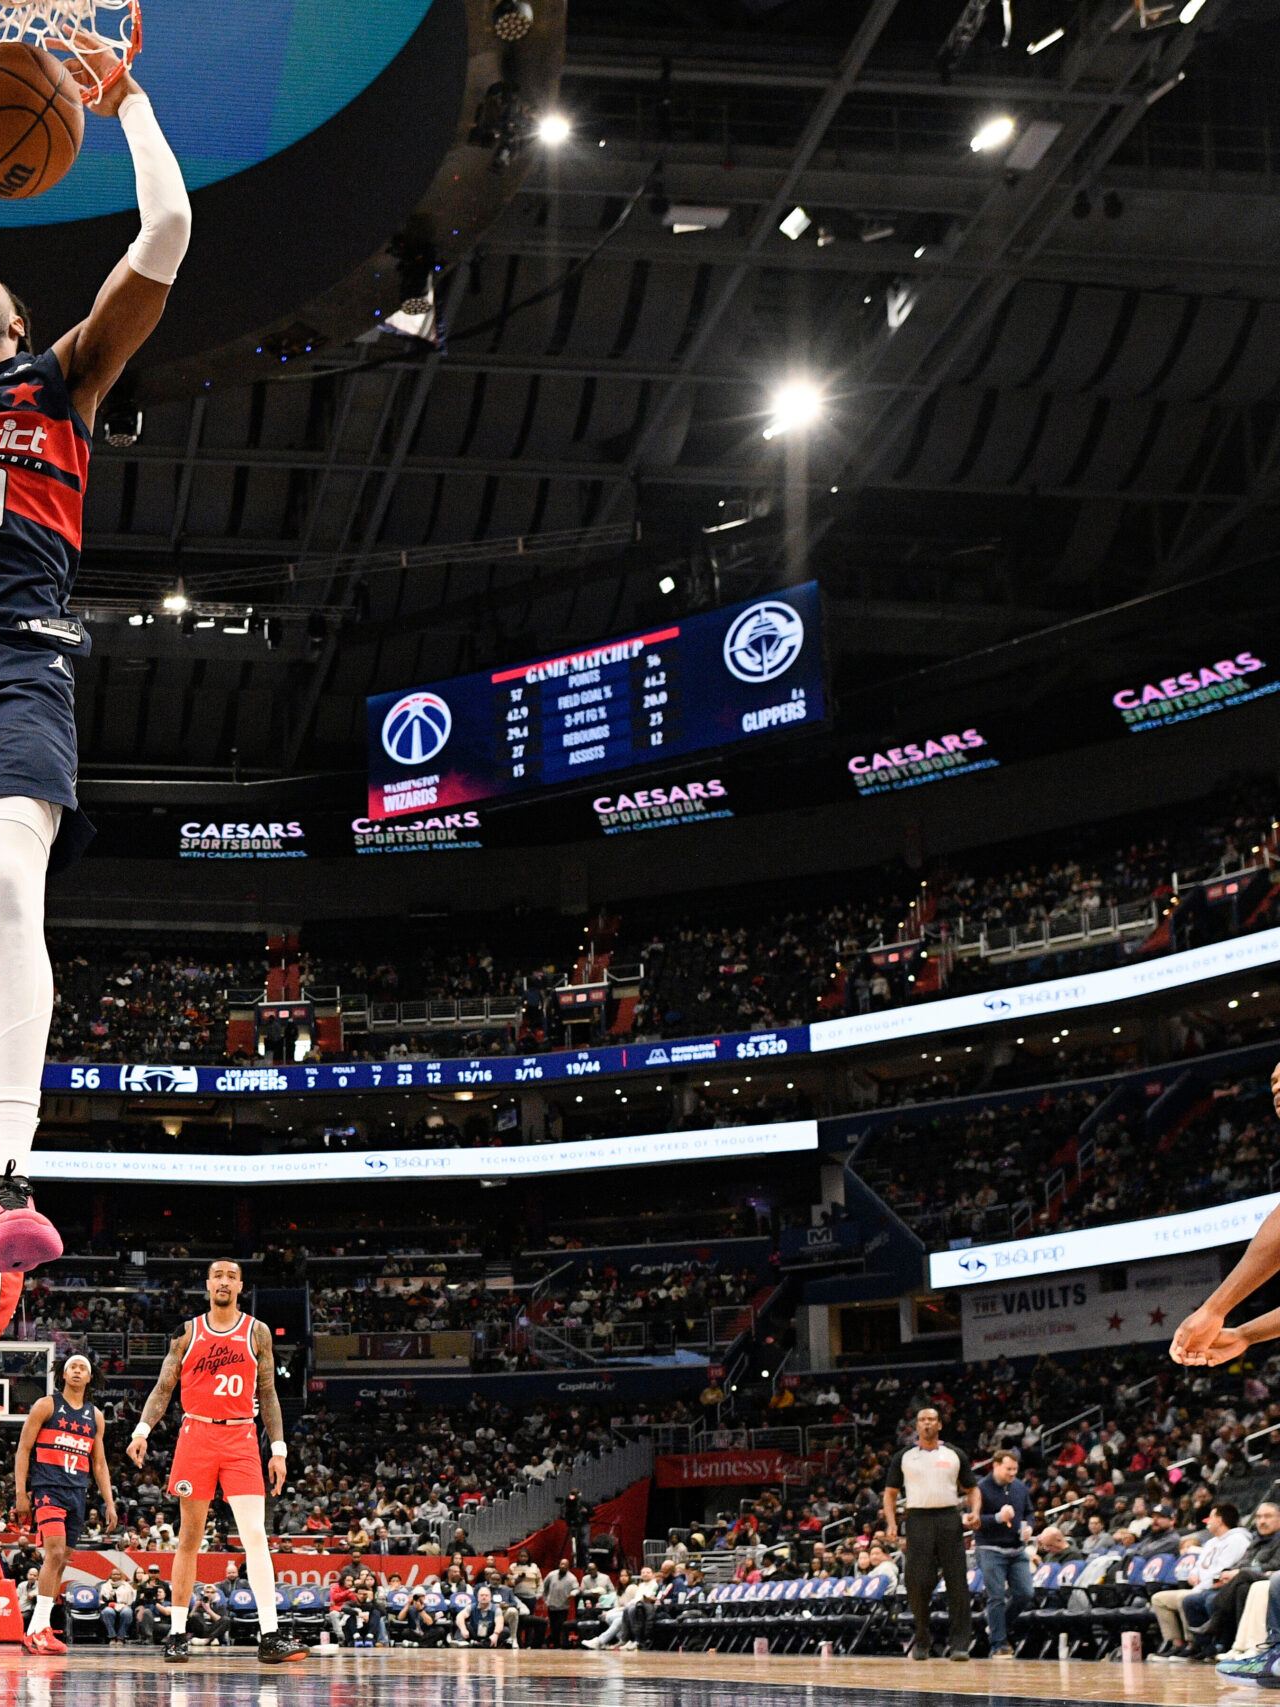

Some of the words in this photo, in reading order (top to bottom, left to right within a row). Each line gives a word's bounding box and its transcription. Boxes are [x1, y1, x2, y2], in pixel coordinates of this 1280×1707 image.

[525, 659, 569, 685] GAME
[569, 639, 644, 671] MATCHUP
[568, 669, 601, 688] POINTS
[1112, 651, 1264, 710] CAESARS
[557, 693, 580, 711] FIELD
[581, 690, 602, 707] GOAL
[1121, 678, 1250, 724] SPORTSBOOK
[564, 712, 585, 728] 3-PT
[742, 700, 806, 734] CLIPPERS
[563, 724, 610, 748] REBOUNDS
[568, 745, 606, 766] ASSISTS
[650, 731, 663, 746] 12
[848, 728, 985, 776] CAESARS
[853, 751, 968, 788] SPORTSBOOK
[383, 774, 440, 793] WASHINGTON
[383, 787, 438, 813] WIZARDS
[592, 779, 725, 815] CAESARS
[598, 799, 707, 827] SPORTSBOOK
[180, 821, 304, 839] CAESARS
[354, 828, 458, 846] SPORTSBOOK
[180, 838, 283, 850] SPORTSBOOK
[179, 850, 205, 858] WITH
[578, 1052, 589, 1061] FG
[736, 1039, 788, 1059] $5,920
[225, 1069, 241, 1079] LOS
[242, 1068, 279, 1079] ANGELES
[305, 1068, 319, 1076] TOL
[332, 1066, 356, 1074] FOULS
[372, 1065, 382, 1073] TO
[427, 1062, 441, 1071] AST
[515, 1065, 543, 1081] 3/16
[566, 1060, 600, 1076] 19/44
[70, 1067, 101, 1089] 56
[216, 1076, 288, 1091] CLIPPERS
[307, 1076, 316, 1088] 5
[339, 1075, 348, 1088] 0
[373, 1074, 381, 1086] 7
[397, 1073, 413, 1085] 23
[427, 1072, 442, 1084] 12
[457, 1069, 492, 1083] 15/16
[123, 1162, 167, 1170] MOVING
[1002, 1283, 1088, 1315] VAULTS
[208, 1343, 230, 1359] Los
[193, 1350, 246, 1376] Angeles
[213, 1373, 244, 1397] 20
[64, 1453, 78, 1475] 12
[682, 1456, 771, 1481] Hennessy
